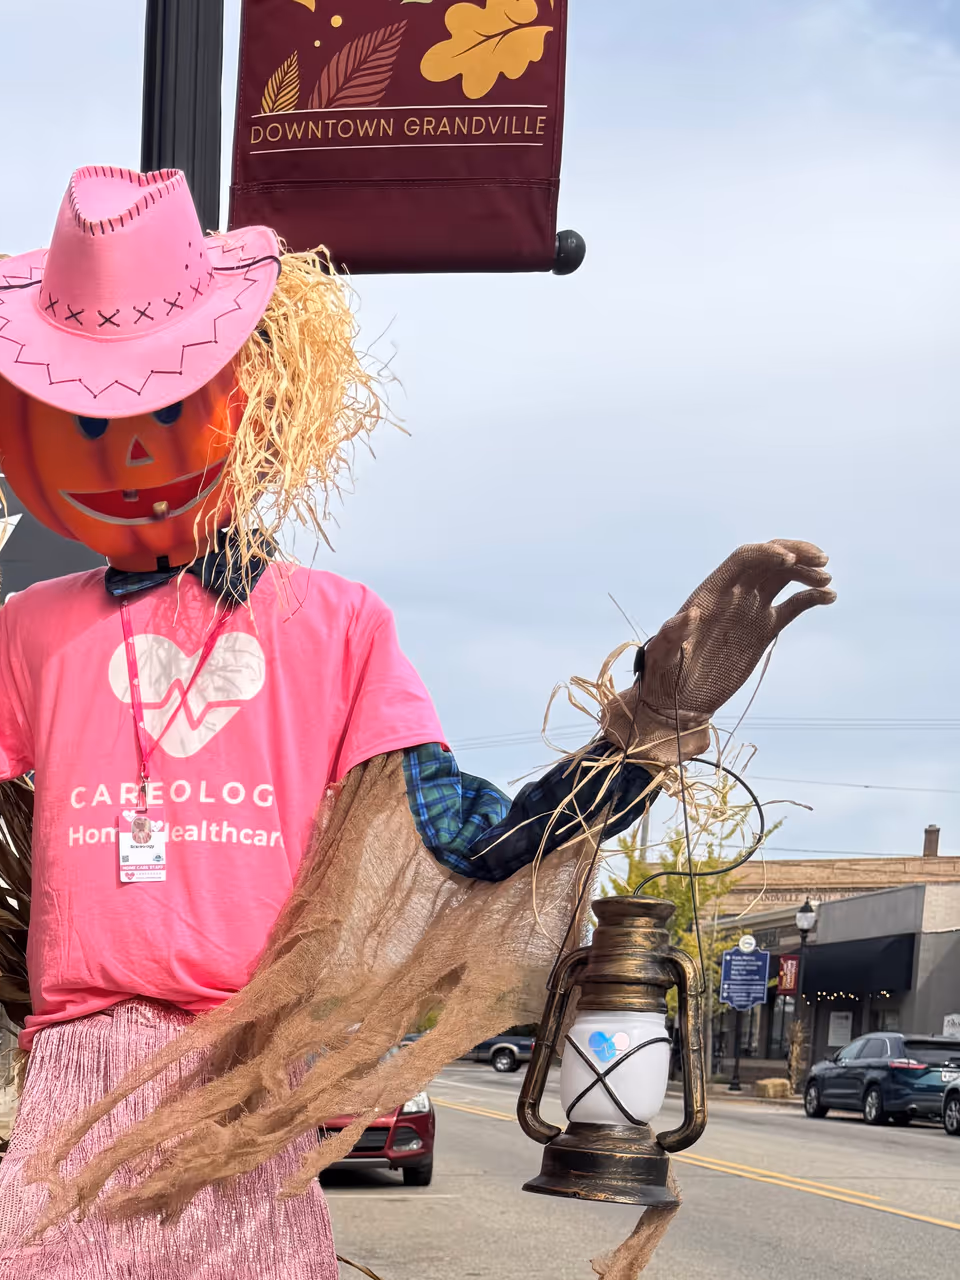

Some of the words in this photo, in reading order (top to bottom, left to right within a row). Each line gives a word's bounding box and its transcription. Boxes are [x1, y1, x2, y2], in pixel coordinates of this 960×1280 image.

[250, 118, 394, 144] DOWNTOWN
[404, 116, 547, 137] GRANDVILLE
[70, 779, 274, 809] CAREOLOG
[68, 826, 119, 847] Hom
[164, 820, 284, 848] ealthcar
